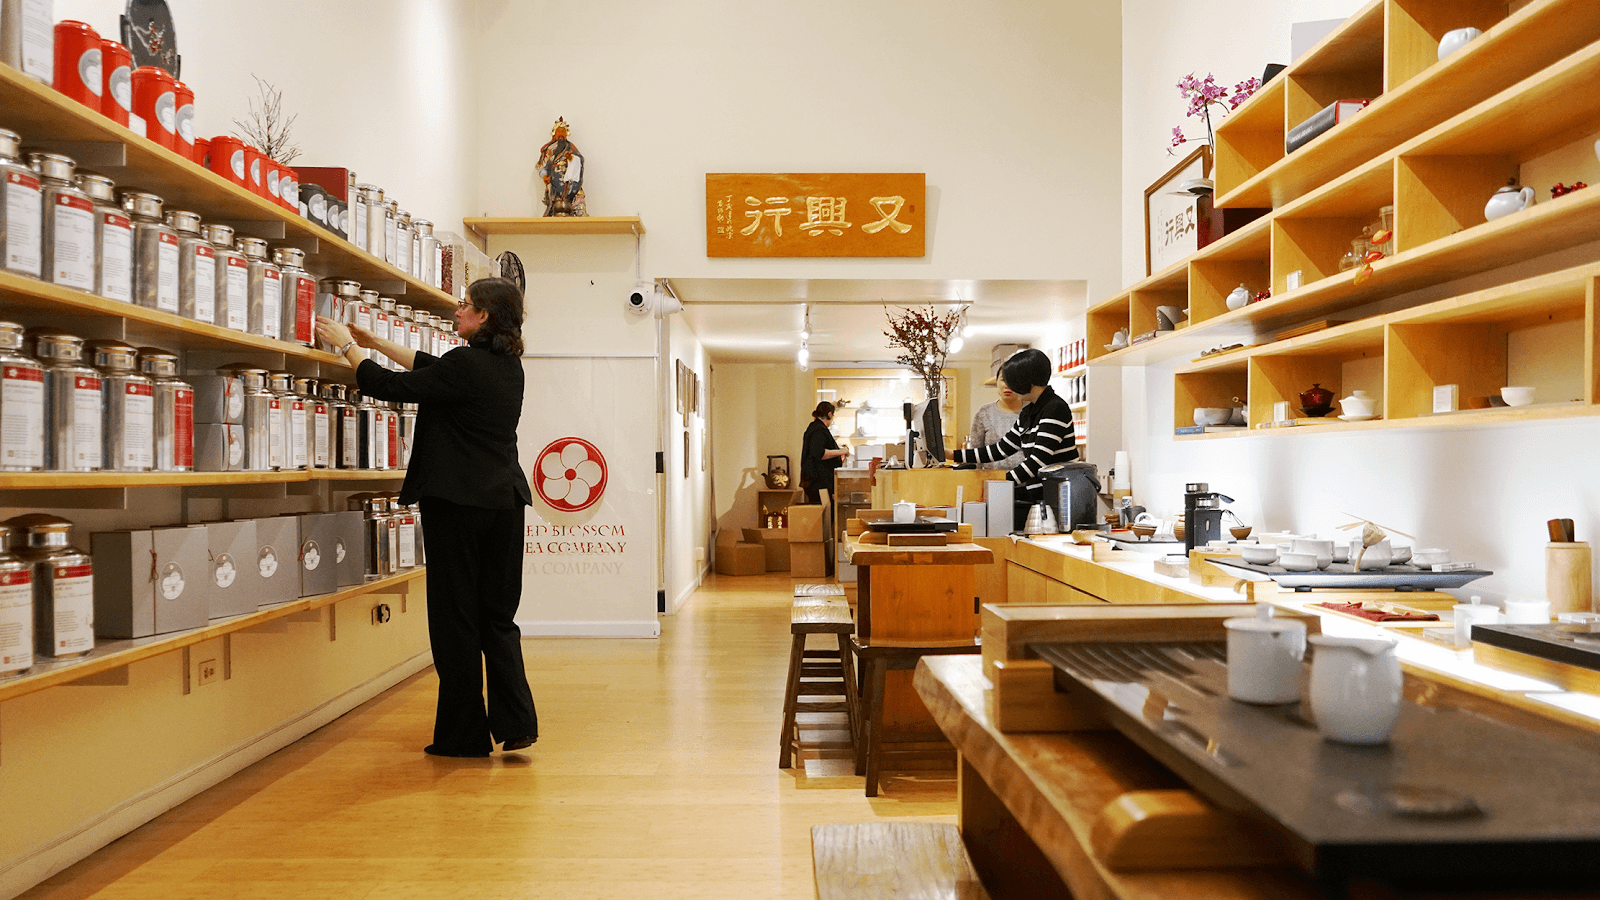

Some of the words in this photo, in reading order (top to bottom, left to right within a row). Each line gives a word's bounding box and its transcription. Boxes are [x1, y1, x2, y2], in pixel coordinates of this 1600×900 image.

[525, 525, 547, 537] ED
[552, 525, 626, 537] BLOSSOM
[525, 541, 544, 554] EA
[547, 541, 627, 554] COMPANY
